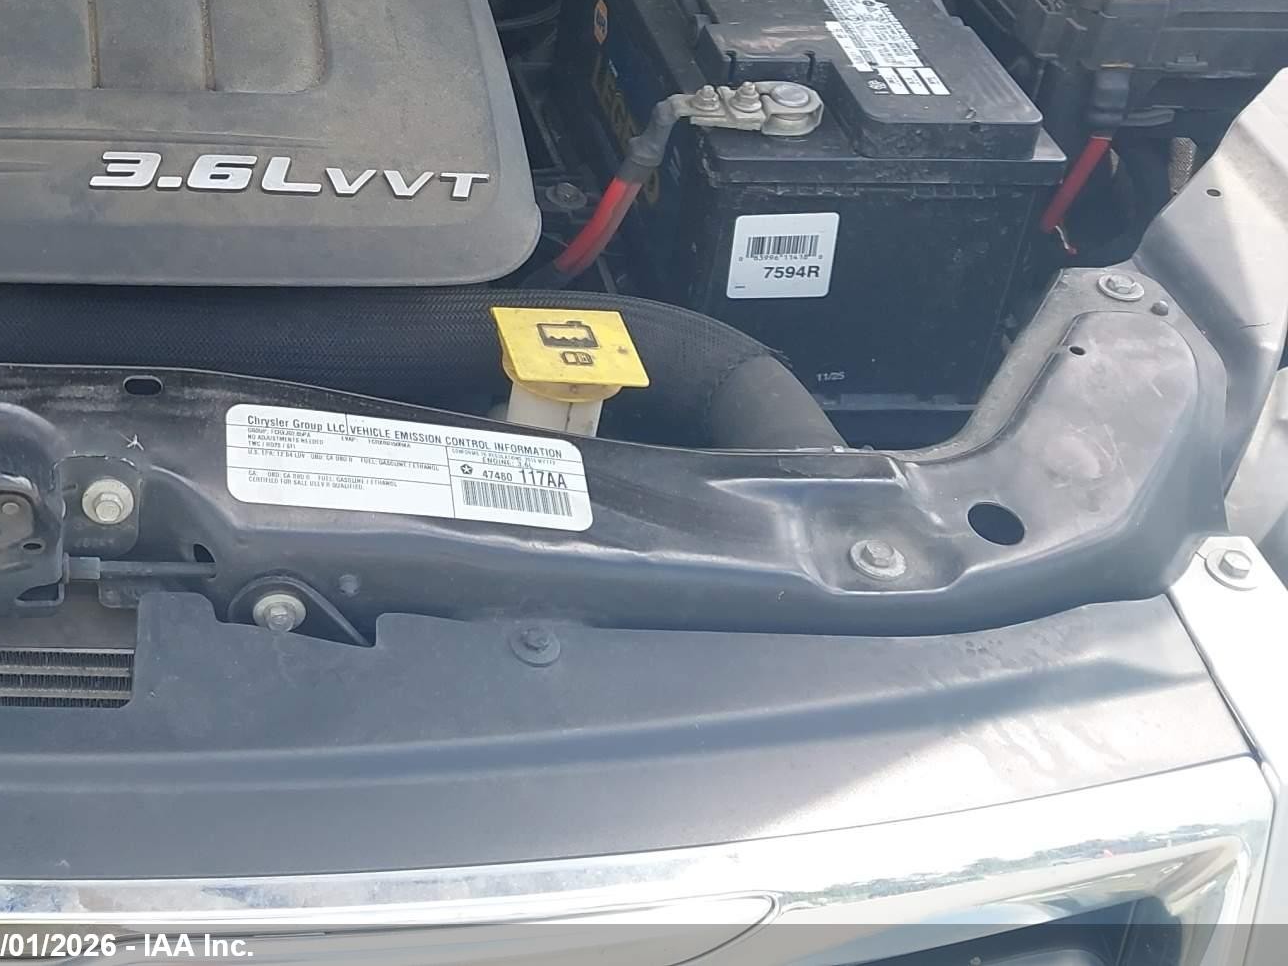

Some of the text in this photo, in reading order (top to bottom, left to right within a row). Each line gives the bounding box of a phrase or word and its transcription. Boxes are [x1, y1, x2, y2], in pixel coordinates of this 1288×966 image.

[89, 151, 490, 201] 3.6L VVT
[763, 265, 820, 279] 7594R
[247, 414, 345, 433] Chrysler Group LLC
[257, 434, 300, 443] ADJUSTMENTS
[349, 424, 391, 439] VEHICLE
[394, 430, 442, 444] EMISSION
[445, 435, 490, 450] CONTROL
[494, 442, 562, 459] INFORMATION
[379, 459, 407, 467] GASOLINE
[412, 462, 440, 471] ETHANOL
[482, 456, 514, 466] ENGINE:
[248, 476, 279, 484] CERTIFIED
[336, 476, 364, 484] GASOLINE
[371, 479, 398, 488] ETHANOL
[482, 468, 568, 489] 47480 117AA
